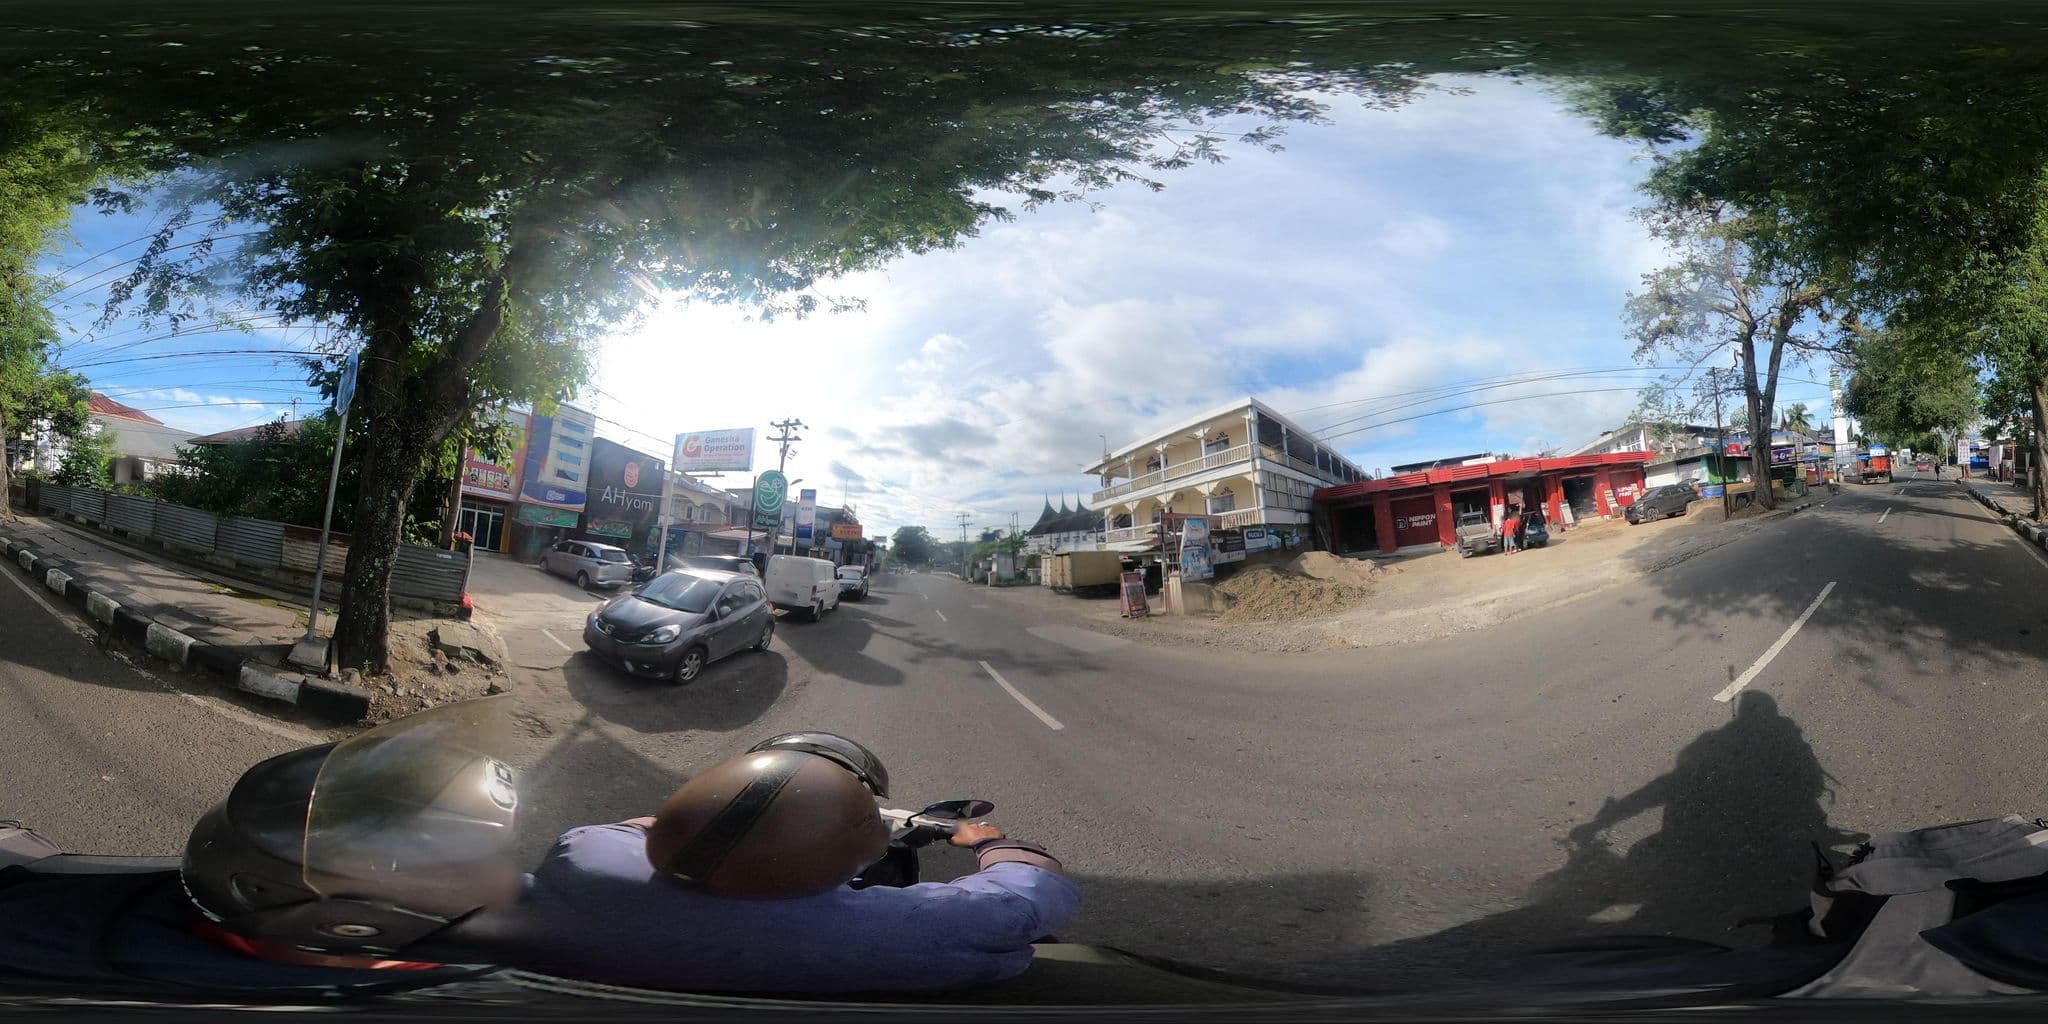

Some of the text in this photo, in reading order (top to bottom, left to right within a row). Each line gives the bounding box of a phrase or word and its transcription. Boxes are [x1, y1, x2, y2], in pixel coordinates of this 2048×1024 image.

[703, 443, 745, 454] Operation
[600, 484, 652, 512] AHyam
[1408, 513, 1436, 523] NIPPON
[1411, 519, 1433, 528] PAINT
